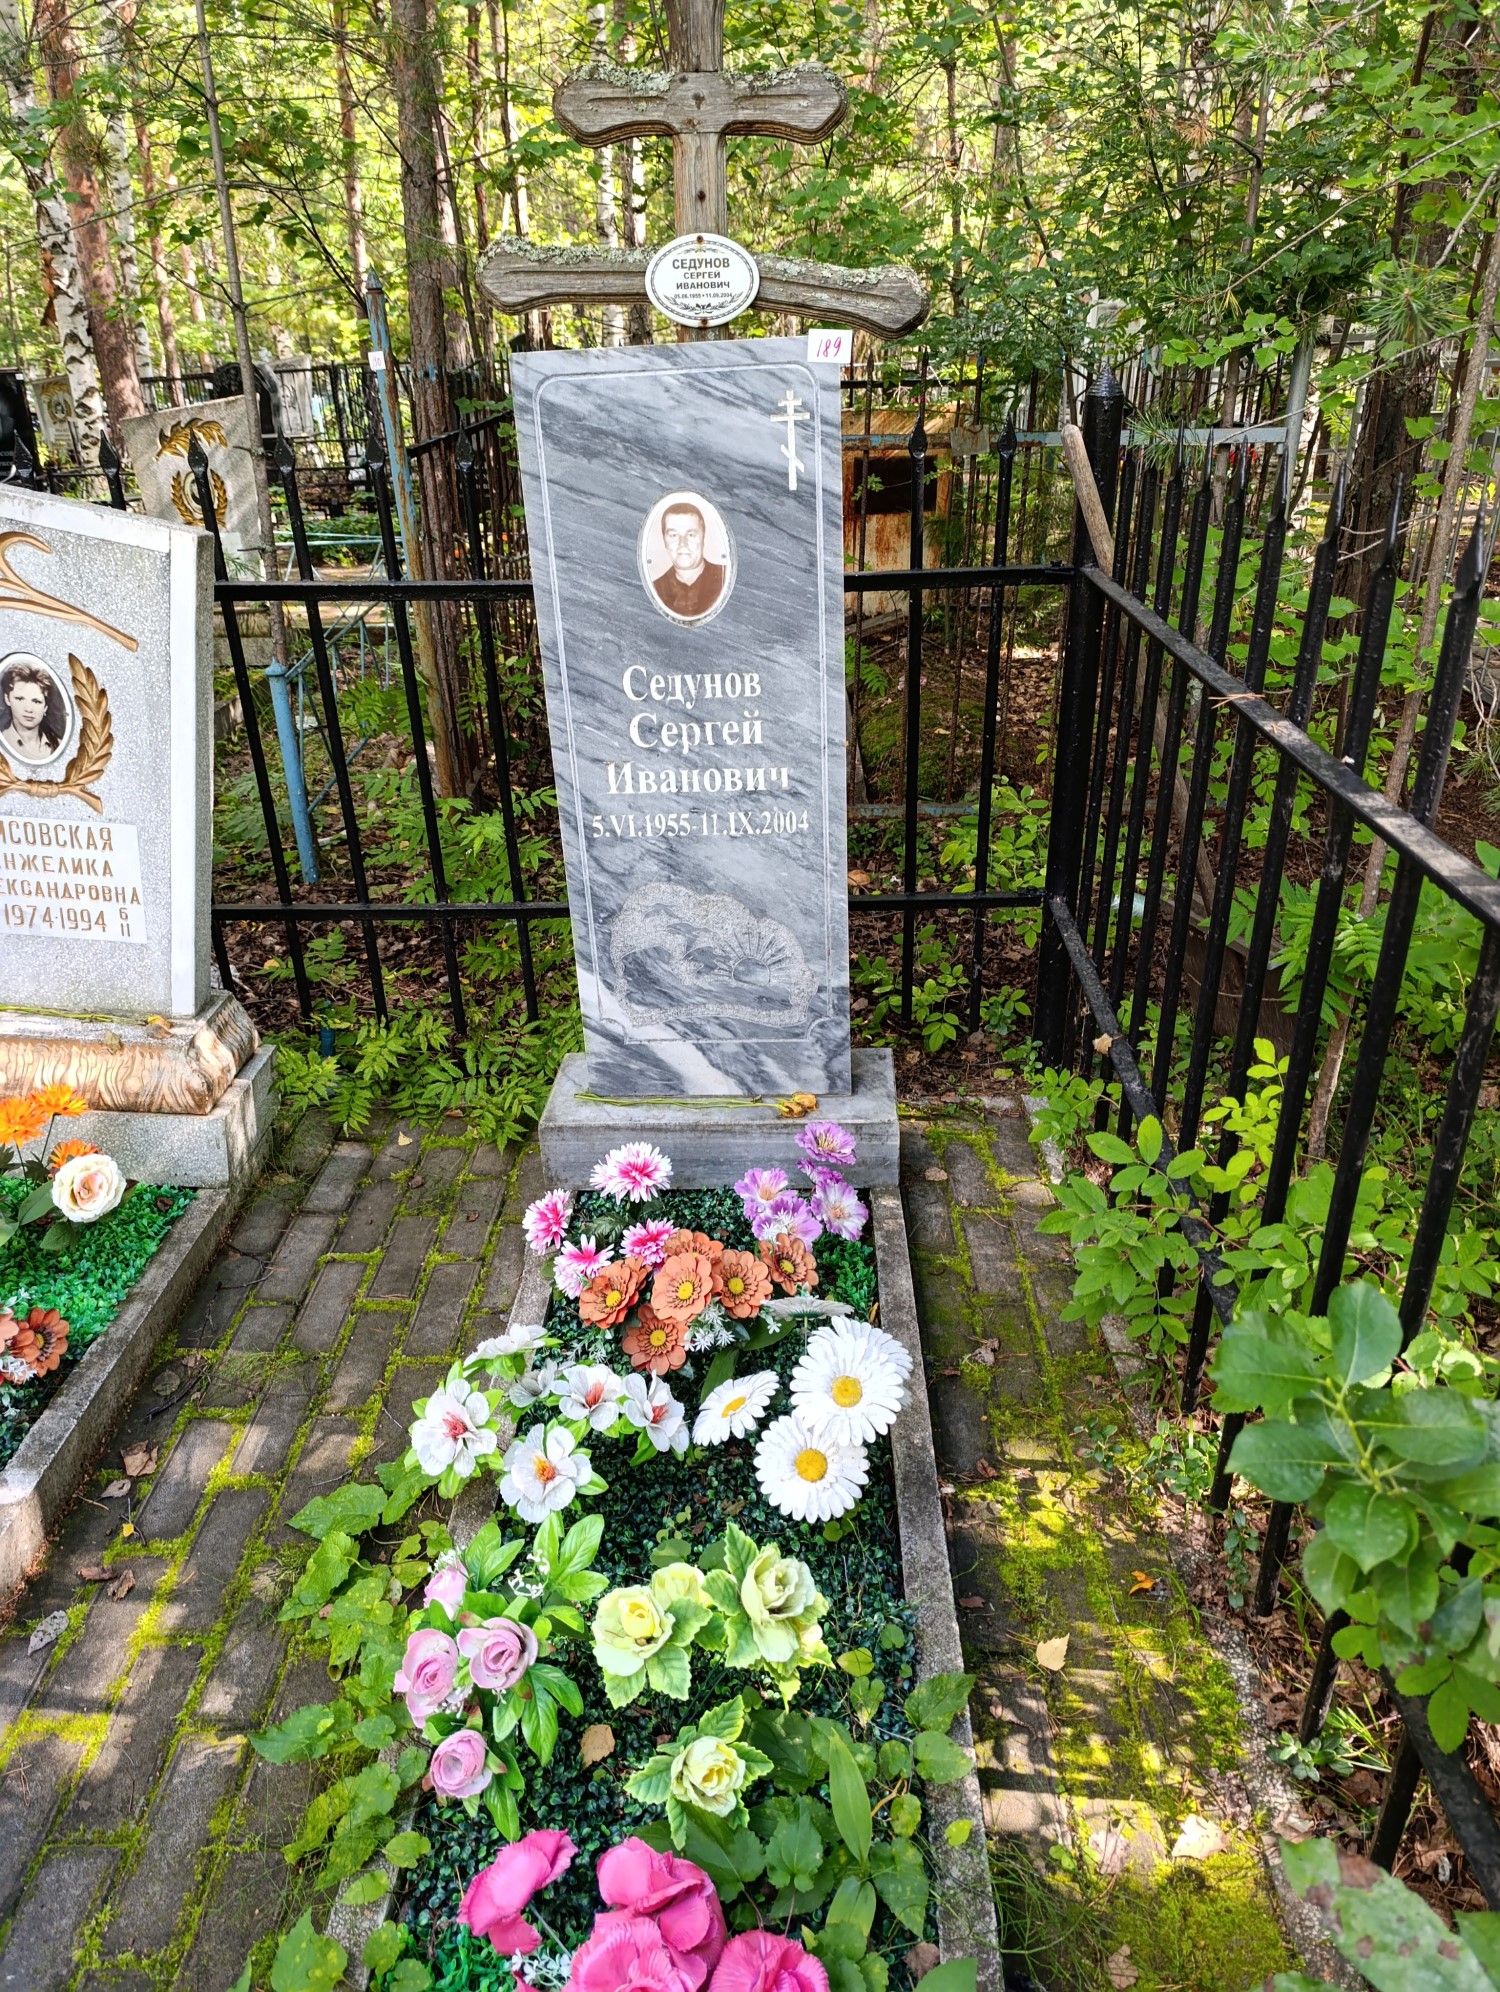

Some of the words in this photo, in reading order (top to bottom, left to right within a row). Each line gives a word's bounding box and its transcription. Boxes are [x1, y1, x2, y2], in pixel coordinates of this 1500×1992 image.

[672, 258, 730, 270] СЕДУНОВ
[683, 270, 721, 280] СЕРГЕЙ
[676, 281, 730, 290] ИВАНОВИЧ
[816, 336, 842, 358] 189
[622, 664, 762, 709] Седунов
[629, 709, 763, 755] Сергей
[602, 760, 789, 795] Иванович
[0, 852, 114, 878] НЖЕЛИКА
